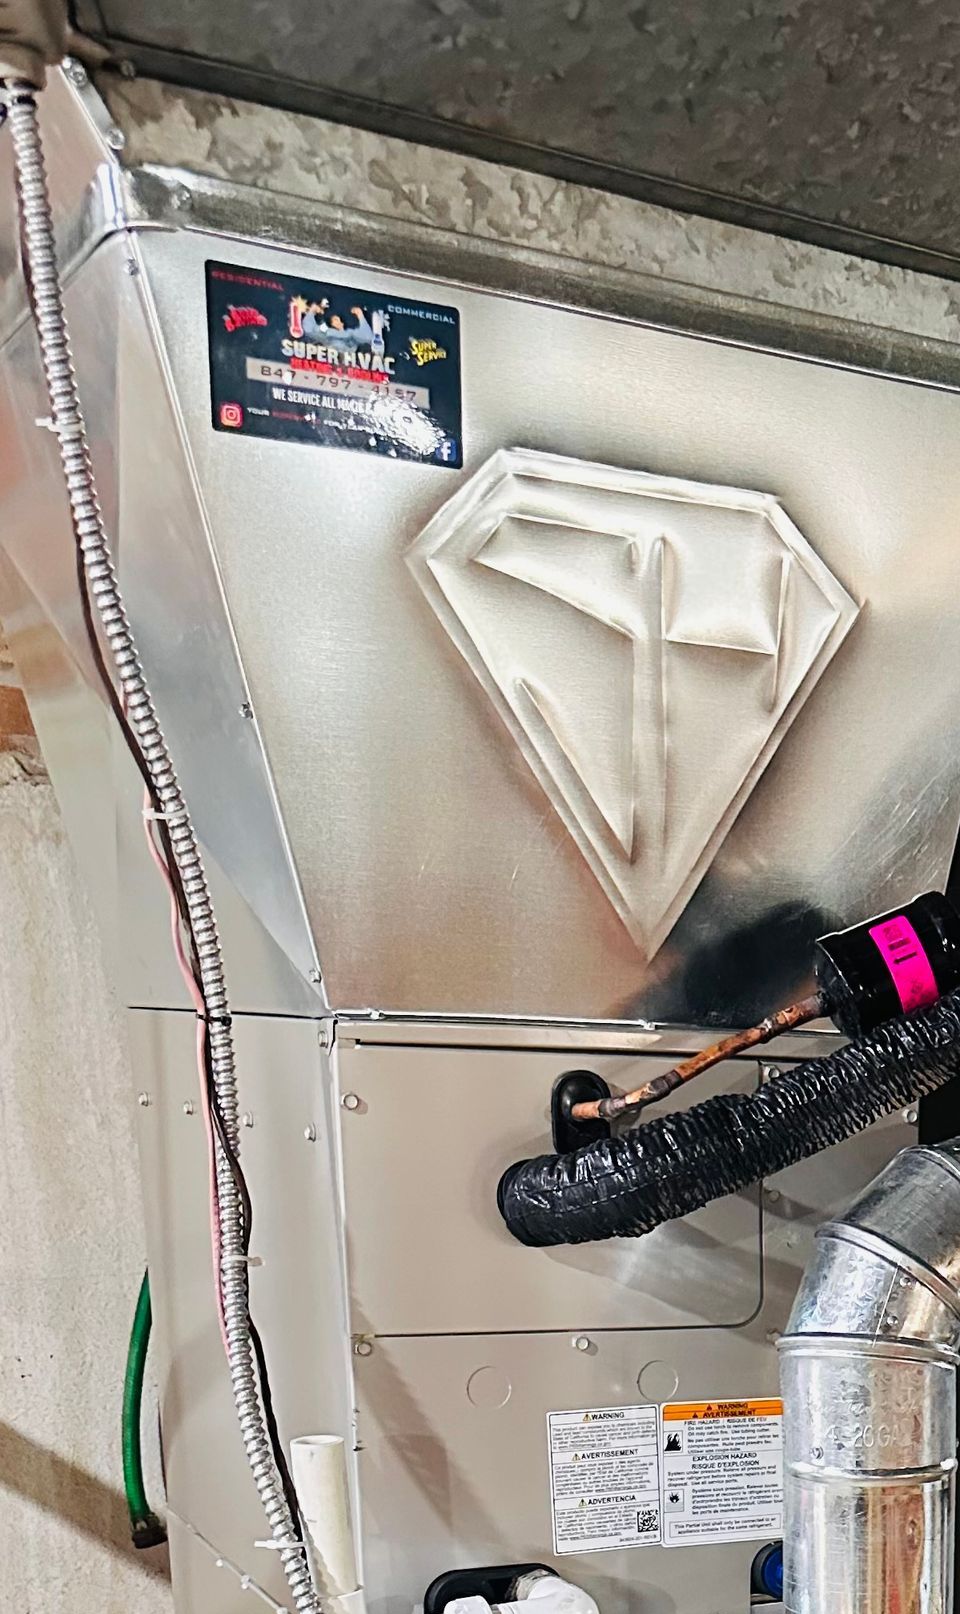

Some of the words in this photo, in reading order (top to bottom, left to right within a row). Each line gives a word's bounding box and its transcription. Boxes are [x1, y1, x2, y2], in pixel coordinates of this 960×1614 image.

[388, 304, 456, 325] COMMERCIAL
[281, 339, 340, 367] SUPER
[342, 351, 396, 375] HVAC
[272, 387, 287, 400] WE
[287, 390, 321, 406] SERVICE
[321, 396, 336, 409] ALL
[718, 1402, 747, 1410] WARNING
[591, 1411, 624, 1420] WARNING
[702, 1409, 755, 1418] AVERTISSEMENT
[581, 1448, 638, 1459] AVERTISSEMENT
[692, 1453, 728, 1462] EXPLOSION
[730, 1451, 757, 1459] HAZARD
[587, 1494, 635, 1505] ADVERTENCIA
